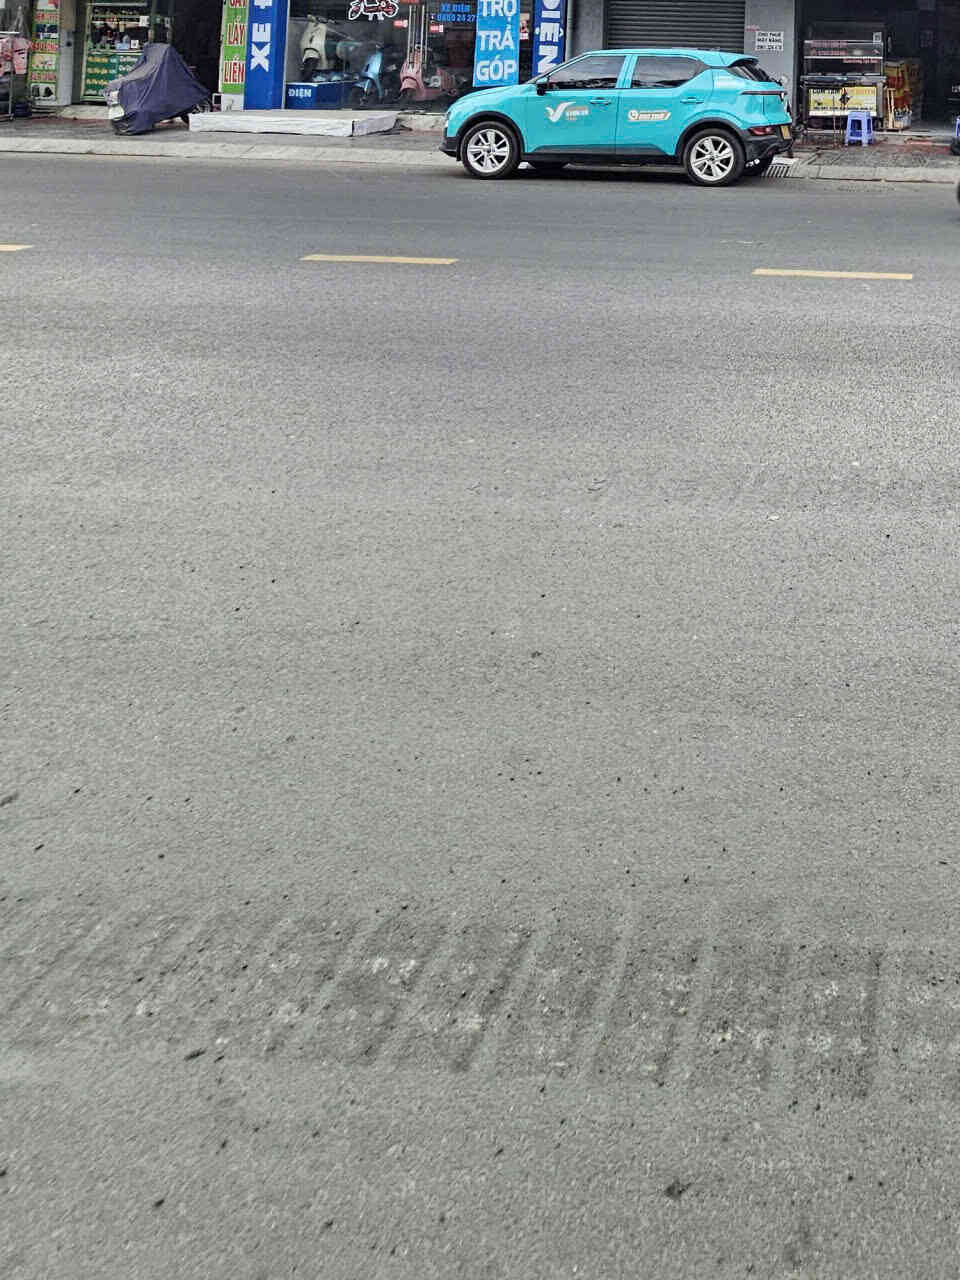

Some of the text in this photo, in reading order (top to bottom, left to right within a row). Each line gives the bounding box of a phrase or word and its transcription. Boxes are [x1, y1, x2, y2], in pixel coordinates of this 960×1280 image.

[250, 23, 272, 72] XE
[479, 25, 514, 51] TRẢ
[476, 55, 516, 81] GÓP
[288, 88, 312, 98] ĐIỆN
